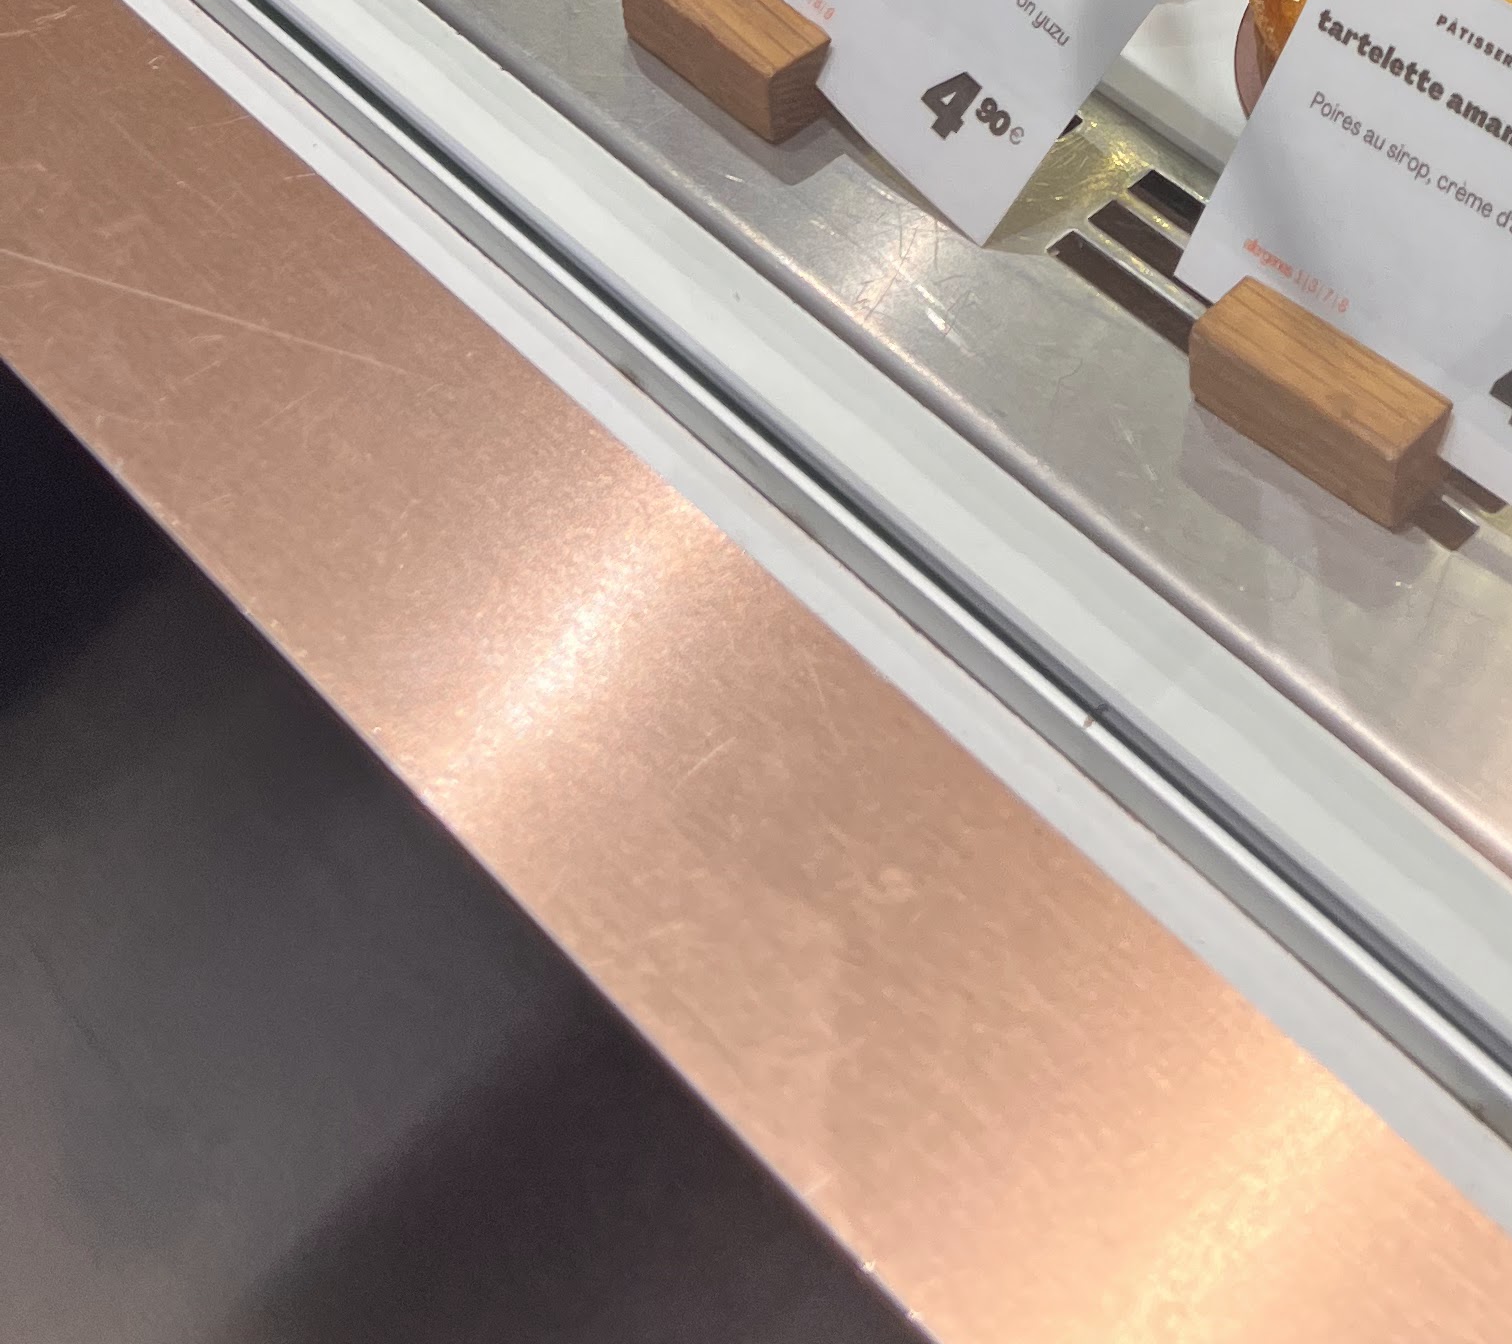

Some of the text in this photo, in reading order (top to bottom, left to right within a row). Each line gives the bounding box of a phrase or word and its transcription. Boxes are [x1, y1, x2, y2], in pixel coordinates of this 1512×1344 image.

[1032, 11, 1070, 46] yuzu
[1318, 9, 1444, 101] tartelette
[1310, 91, 1362, 135] Poires
[1363, 129, 1386, 151] au
[1387, 144, 1431, 185] sirop,
[1437, 175, 1493, 218] crème
